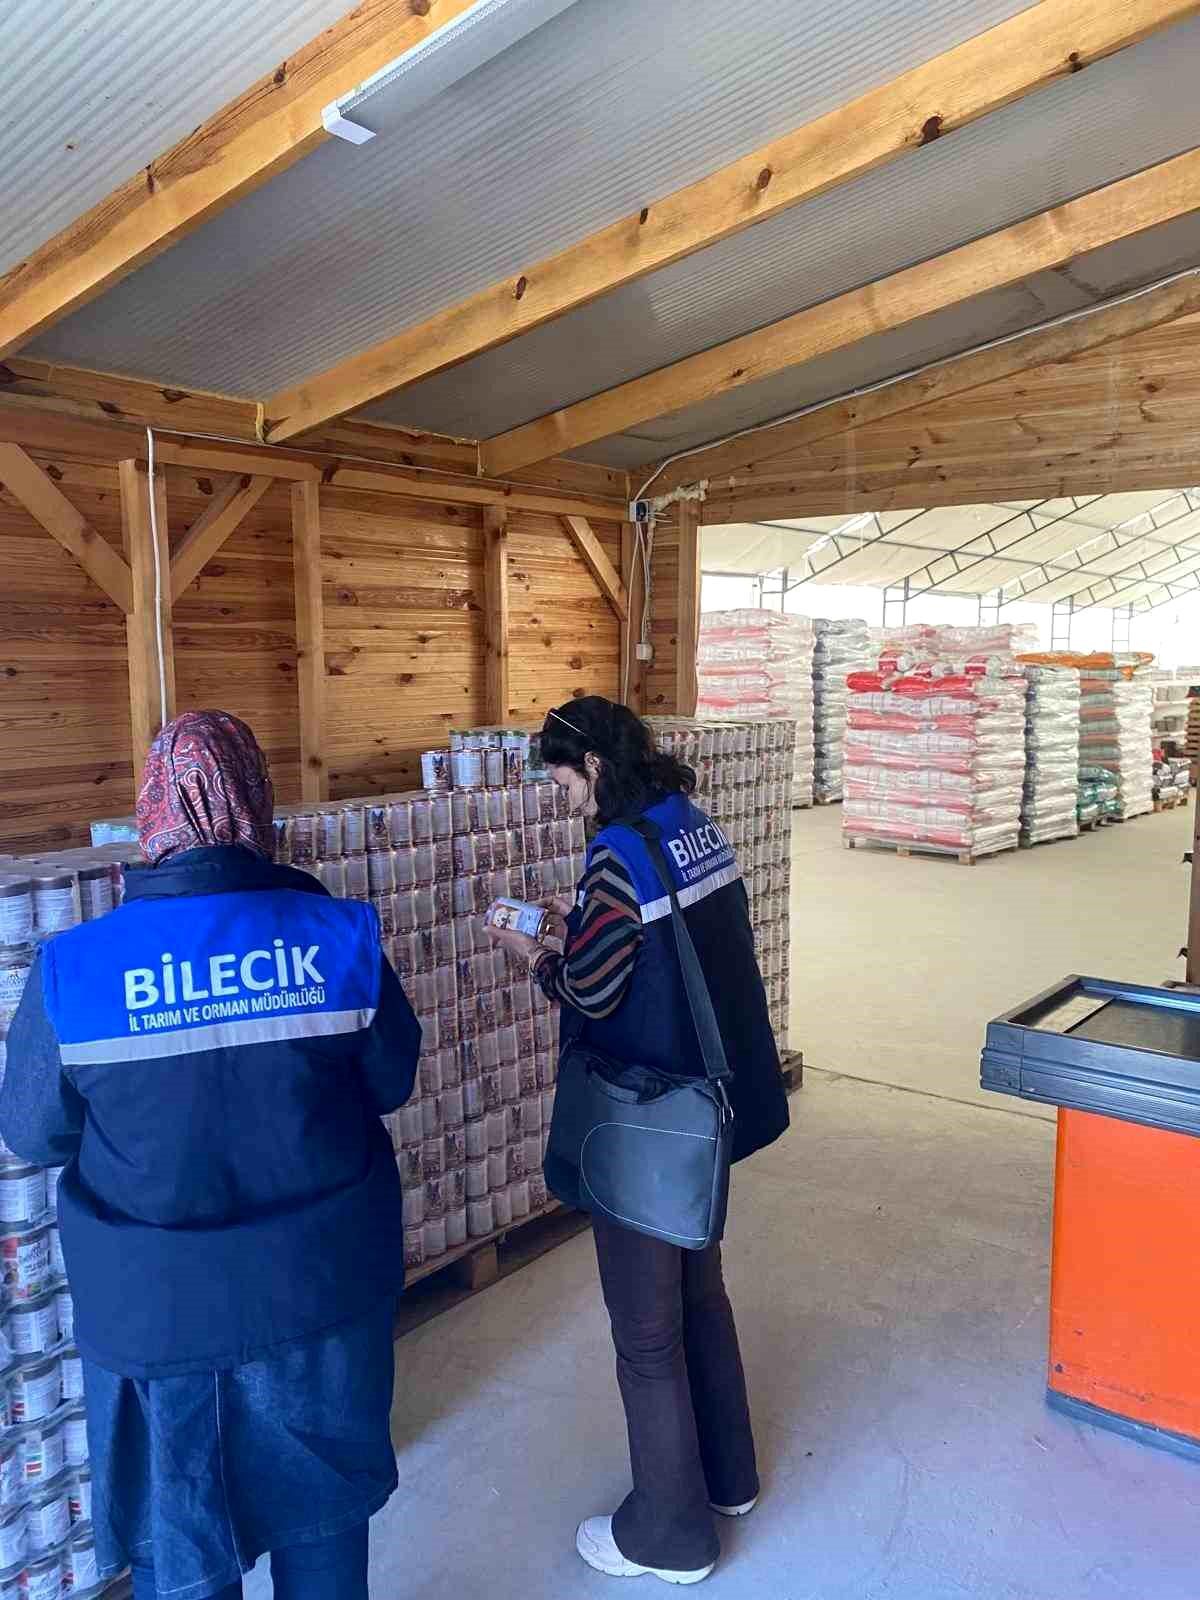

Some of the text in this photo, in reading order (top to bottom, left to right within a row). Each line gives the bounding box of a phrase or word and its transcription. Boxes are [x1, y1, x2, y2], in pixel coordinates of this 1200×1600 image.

[123, 938, 325, 1010] BİLECİK
[129, 986, 325, 1032] İL TARIM VE ORMAN MÜDÜRLÜĞÜ
